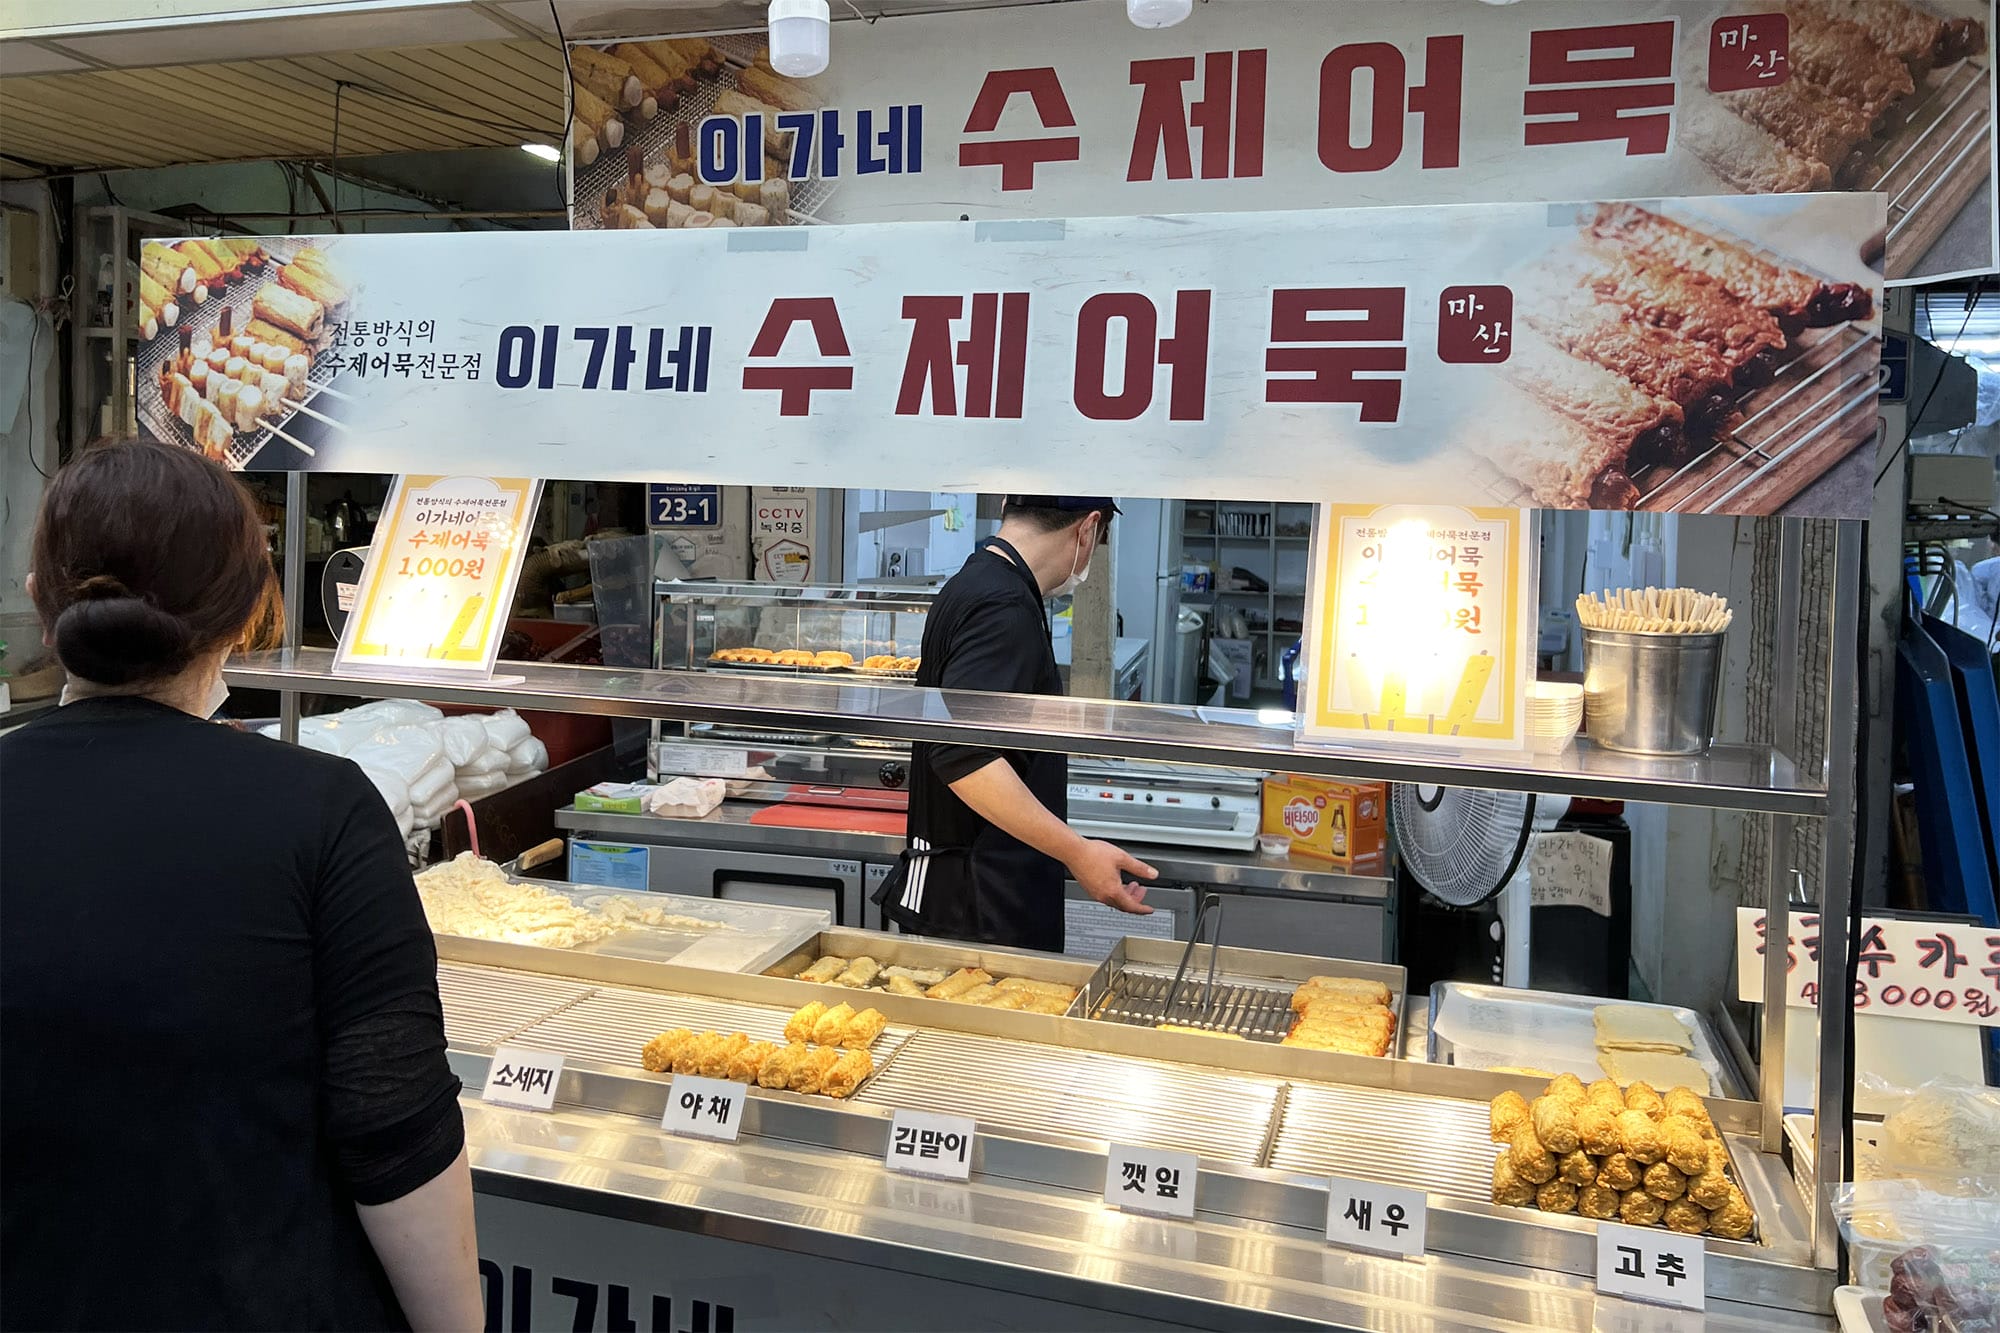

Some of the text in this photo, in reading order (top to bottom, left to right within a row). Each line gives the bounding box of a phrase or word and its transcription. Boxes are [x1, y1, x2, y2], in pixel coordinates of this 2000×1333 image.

[701, 20, 1785, 191] 이가네 수제어묵 마산
[330, 320, 435, 345] 전통방식의
[325, 352, 482, 380] 수제어묵전문점
[497, 287, 1509, 422] 이가네 수제어묵 마산
[659, 498, 709, 521] 23-1
[758, 508, 804, 519] CCTV
[408, 530, 491, 552] 수제어묵
[1362, 543, 1483, 568] 이어묵
[398, 556, 484, 580] 1,000원
[492, 1063, 553, 1095] 소세지
[680, 1091, 731, 1124] 야채
[894, 1127, 967, 1163] 김말이
[1121, 1161, 1180, 1199] 깻잎
[1343, 1197, 1409, 1237] 새우
[1615, 1245, 1687, 1287] 고추
